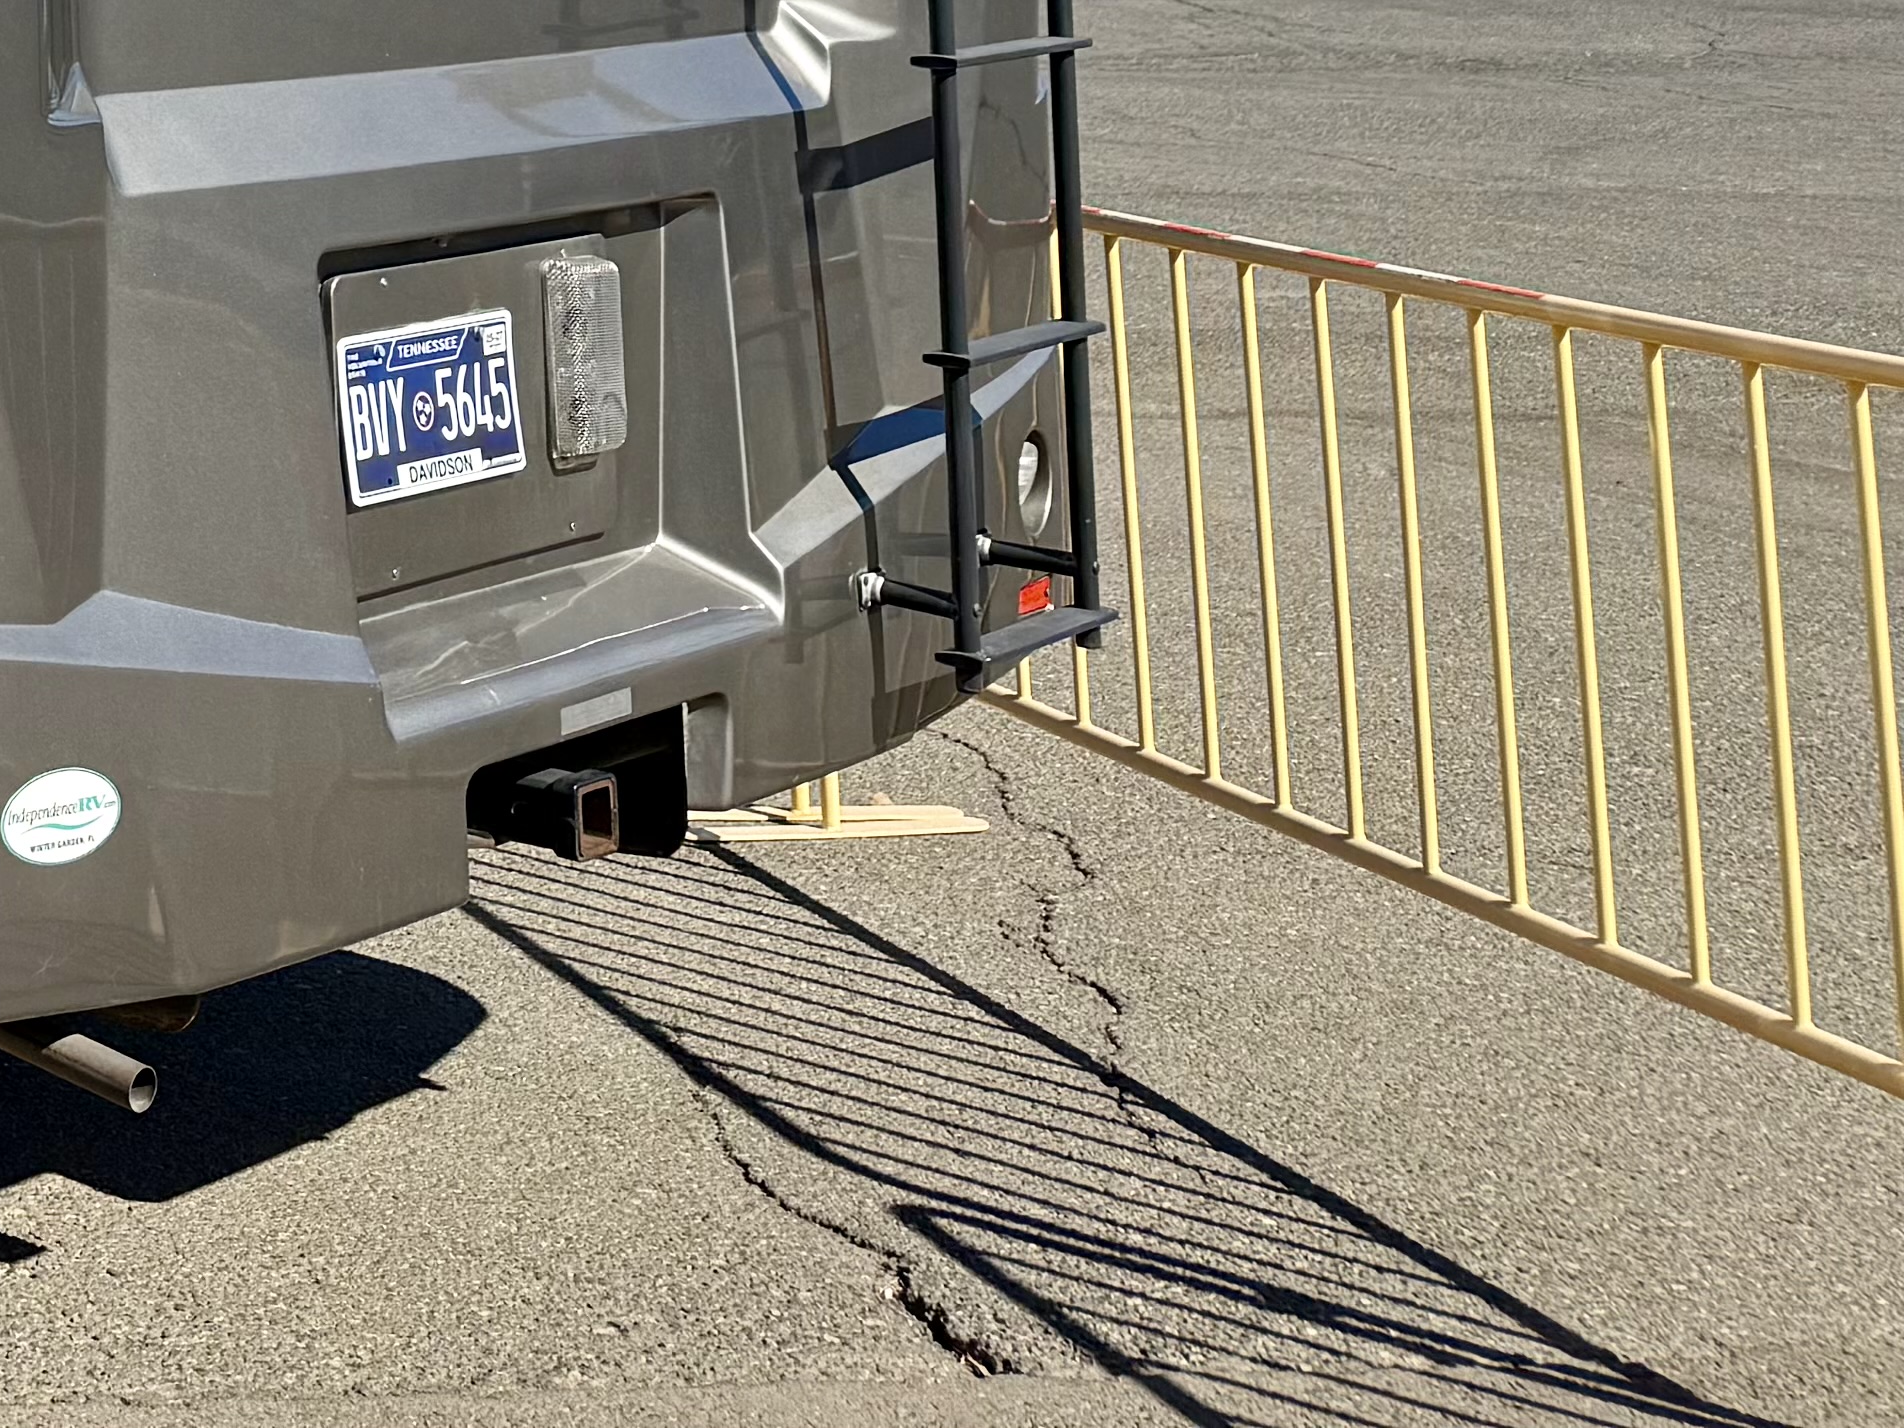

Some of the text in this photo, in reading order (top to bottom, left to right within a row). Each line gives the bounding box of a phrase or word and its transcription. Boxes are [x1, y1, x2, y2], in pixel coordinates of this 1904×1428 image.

[397, 335, 458, 359] TENNESSEE
[349, 357, 512, 461] BVY 5645
[409, 454, 474, 484] DAVIDSON
